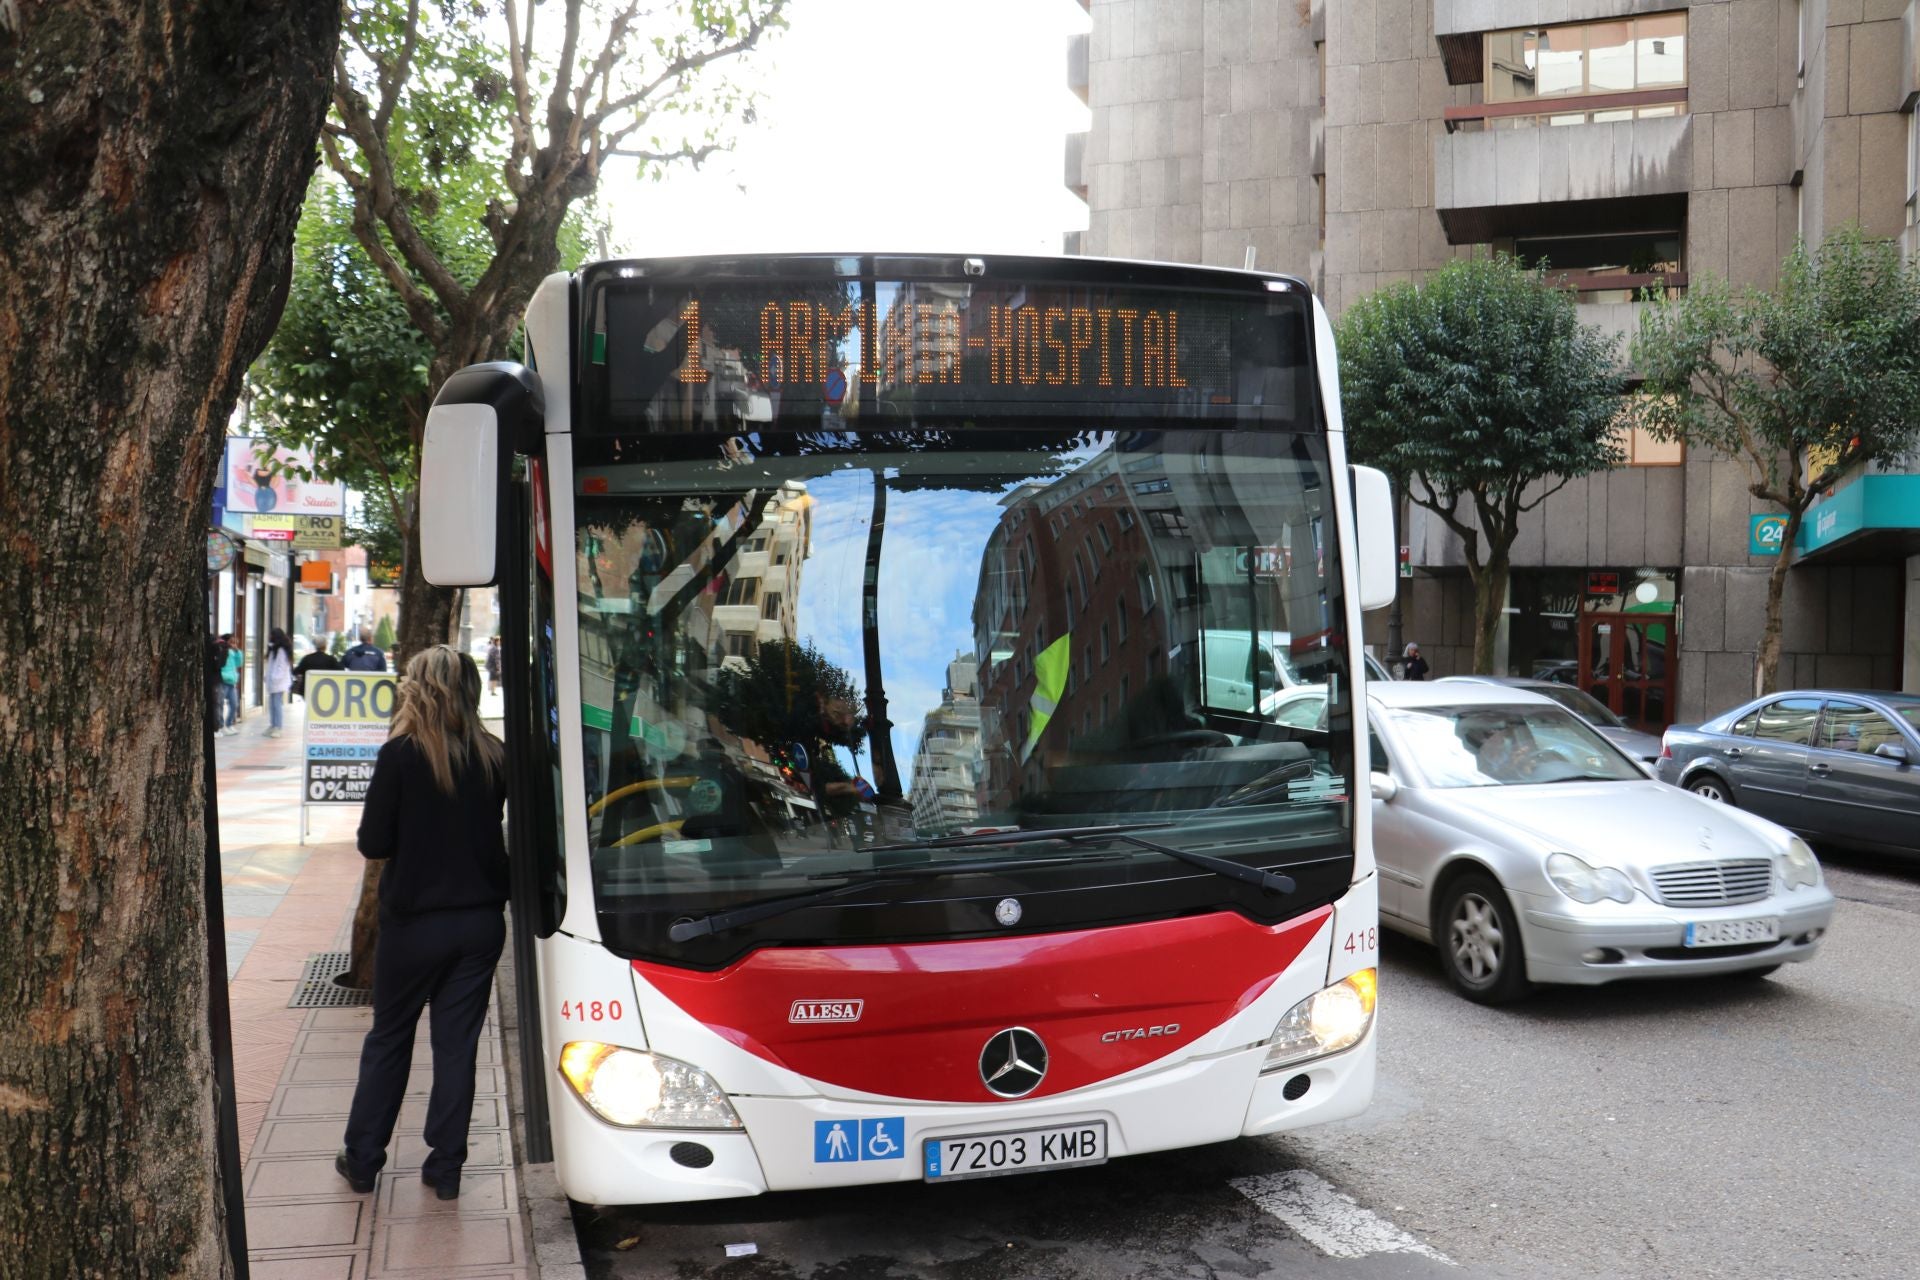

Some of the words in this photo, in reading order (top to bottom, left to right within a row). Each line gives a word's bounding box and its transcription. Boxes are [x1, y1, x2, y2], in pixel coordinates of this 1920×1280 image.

[680, 300, 708, 384] 1
[311, 677, 396, 718] ORO
[308, 746, 356, 757] CAMBIO
[309, 780, 346, 800] 0%
[1344, 926, 1378, 955] 418
[560, 999, 622, 1022] 4180
[794, 1004, 856, 1019] ALESA
[1101, 1023, 1181, 1043] CITARO
[949, 1137, 1027, 1172] 7203
[1041, 1129, 1097, 1162] KMB
[930, 1163, 937, 1172] E
